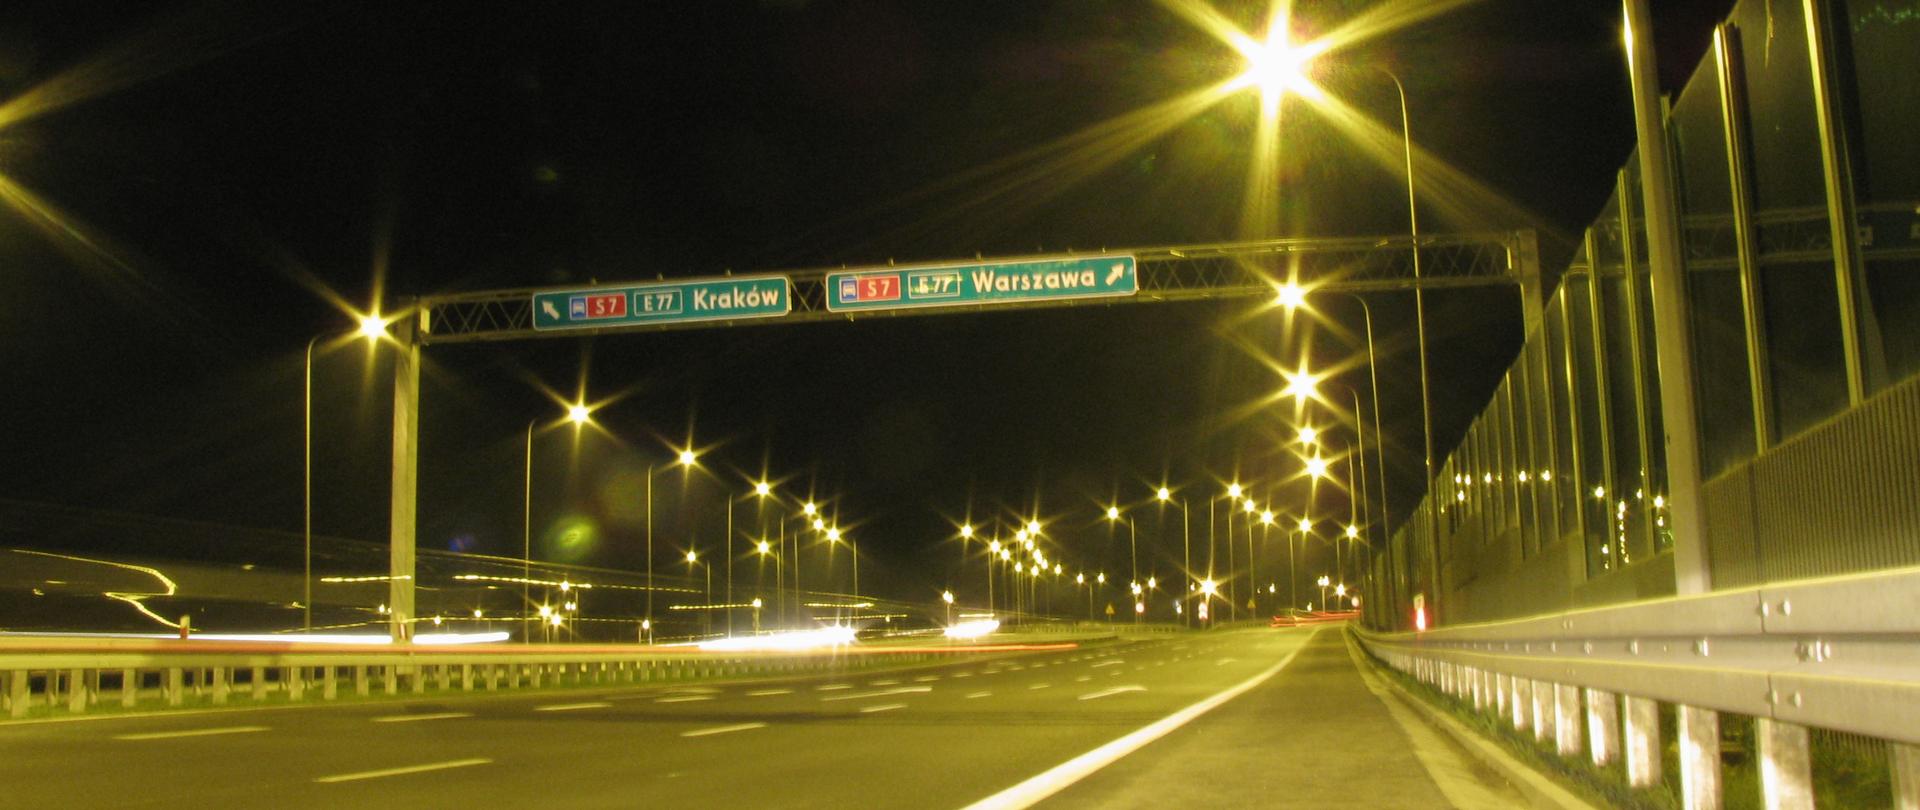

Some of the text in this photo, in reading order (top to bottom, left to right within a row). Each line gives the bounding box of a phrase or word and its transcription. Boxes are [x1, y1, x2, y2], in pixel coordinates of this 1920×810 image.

[867, 279, 890, 297] S 7
[971, 269, 1096, 293] Warszawa
[595, 298, 617, 315] S 7
[644, 293, 673, 311] E 77
[693, 284, 779, 311] Kraków
